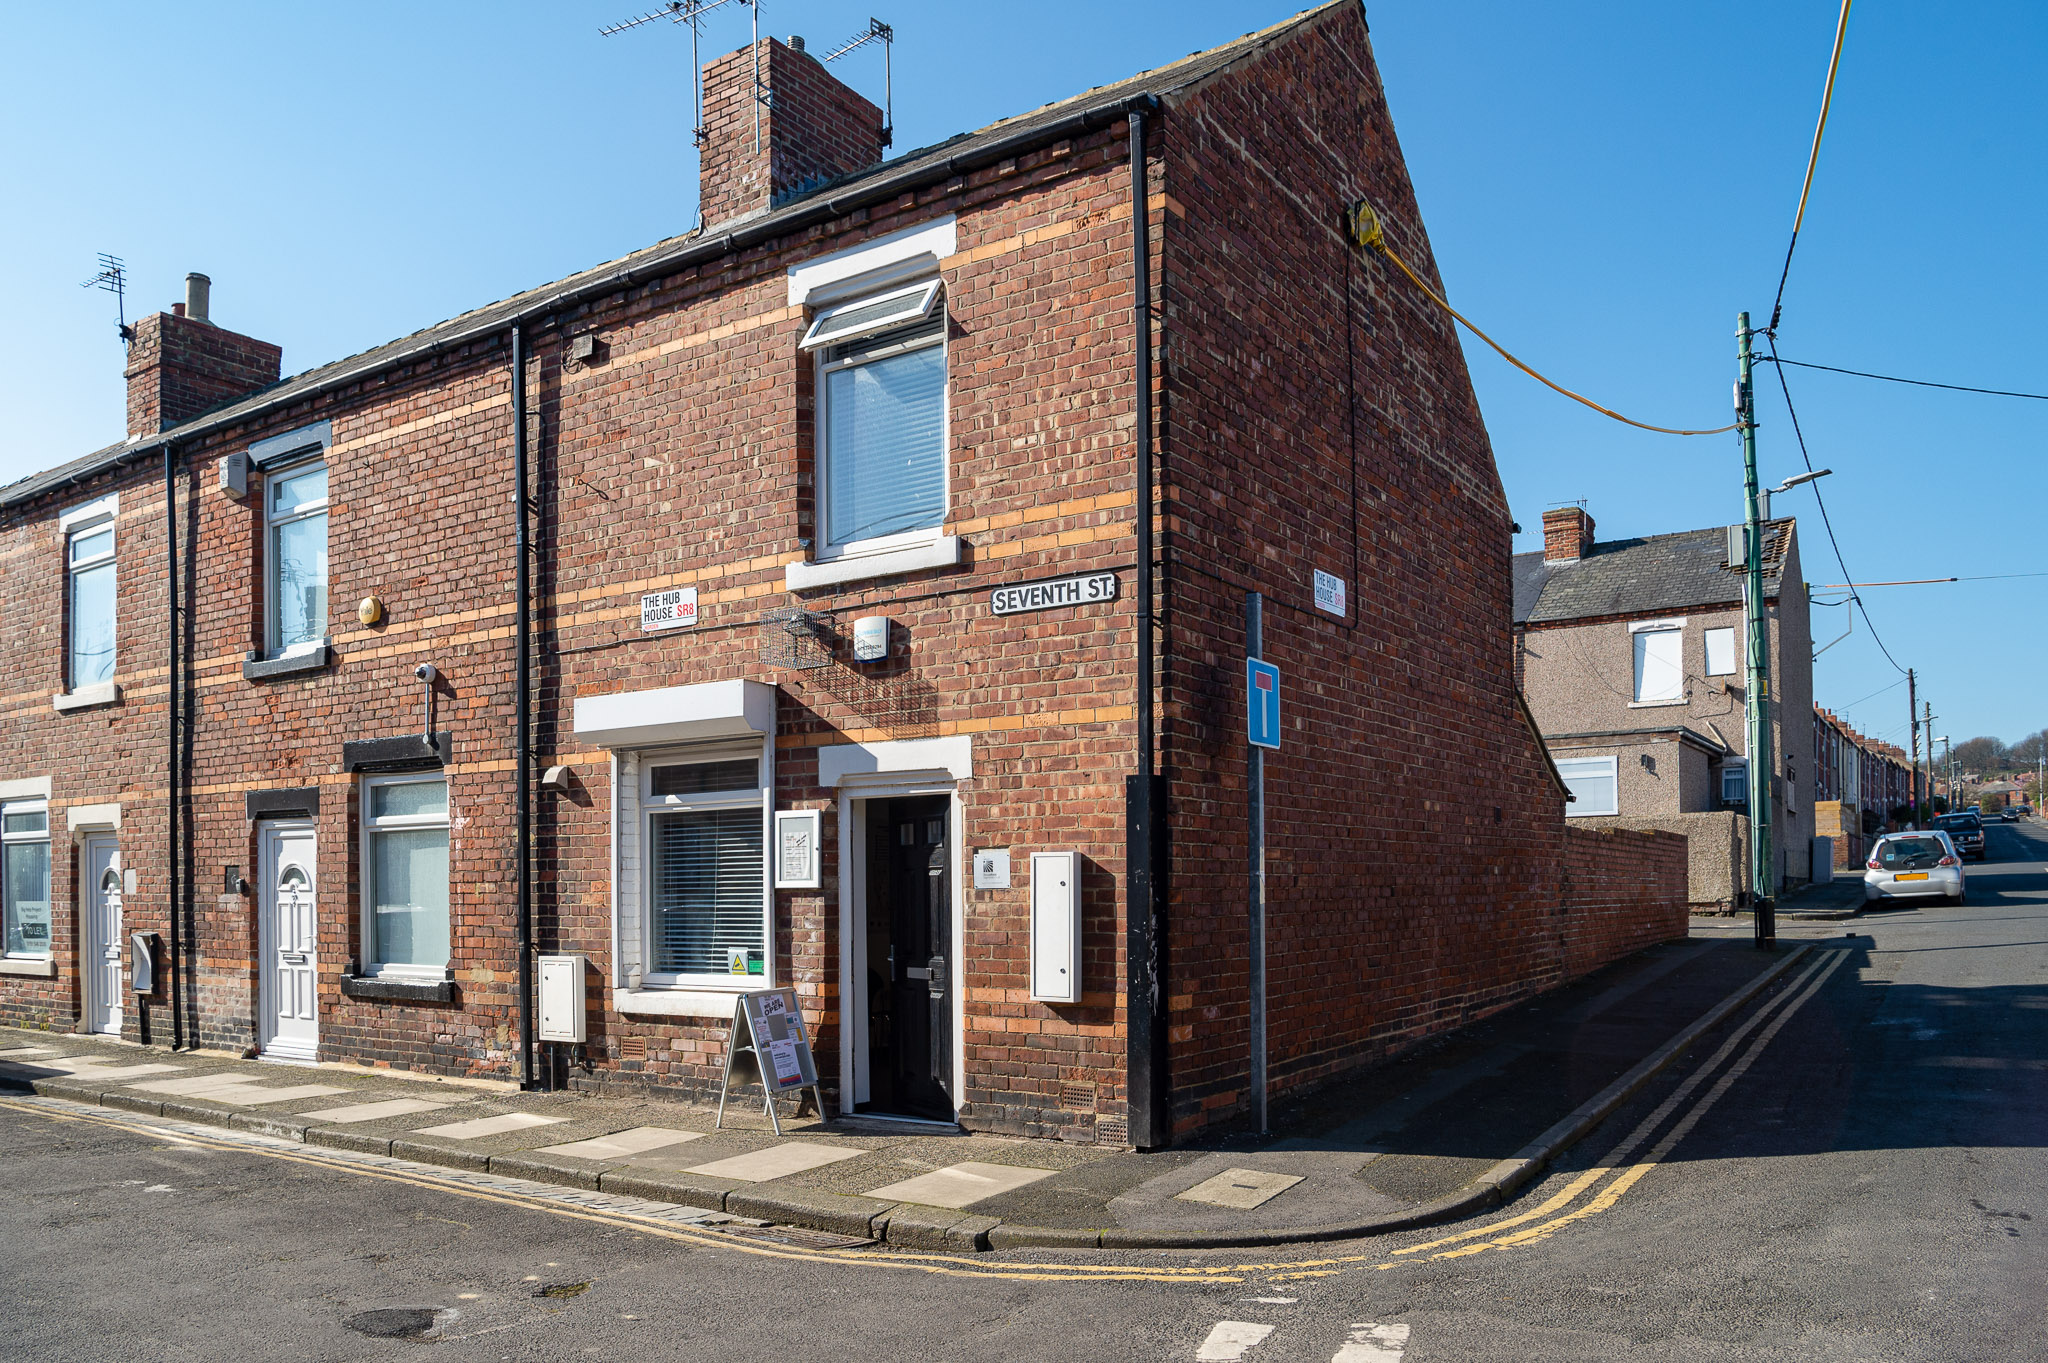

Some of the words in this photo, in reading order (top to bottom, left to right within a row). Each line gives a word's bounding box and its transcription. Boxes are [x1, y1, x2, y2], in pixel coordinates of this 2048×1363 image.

[1316, 571, 1325, 586] THE
[1326, 575, 1337, 591] HUB
[643, 595, 660, 608] THE
[662, 591, 680, 605] HUB
[995, 581, 1080, 611] SEVENTH
[1088, 577, 1113, 598] ST.
[1316, 585, 1333, 602] HOUSE
[644, 606, 672, 622] HOUSE
[677, 603, 694, 617] SR8
[764, 1001, 783, 1016] OPEN
